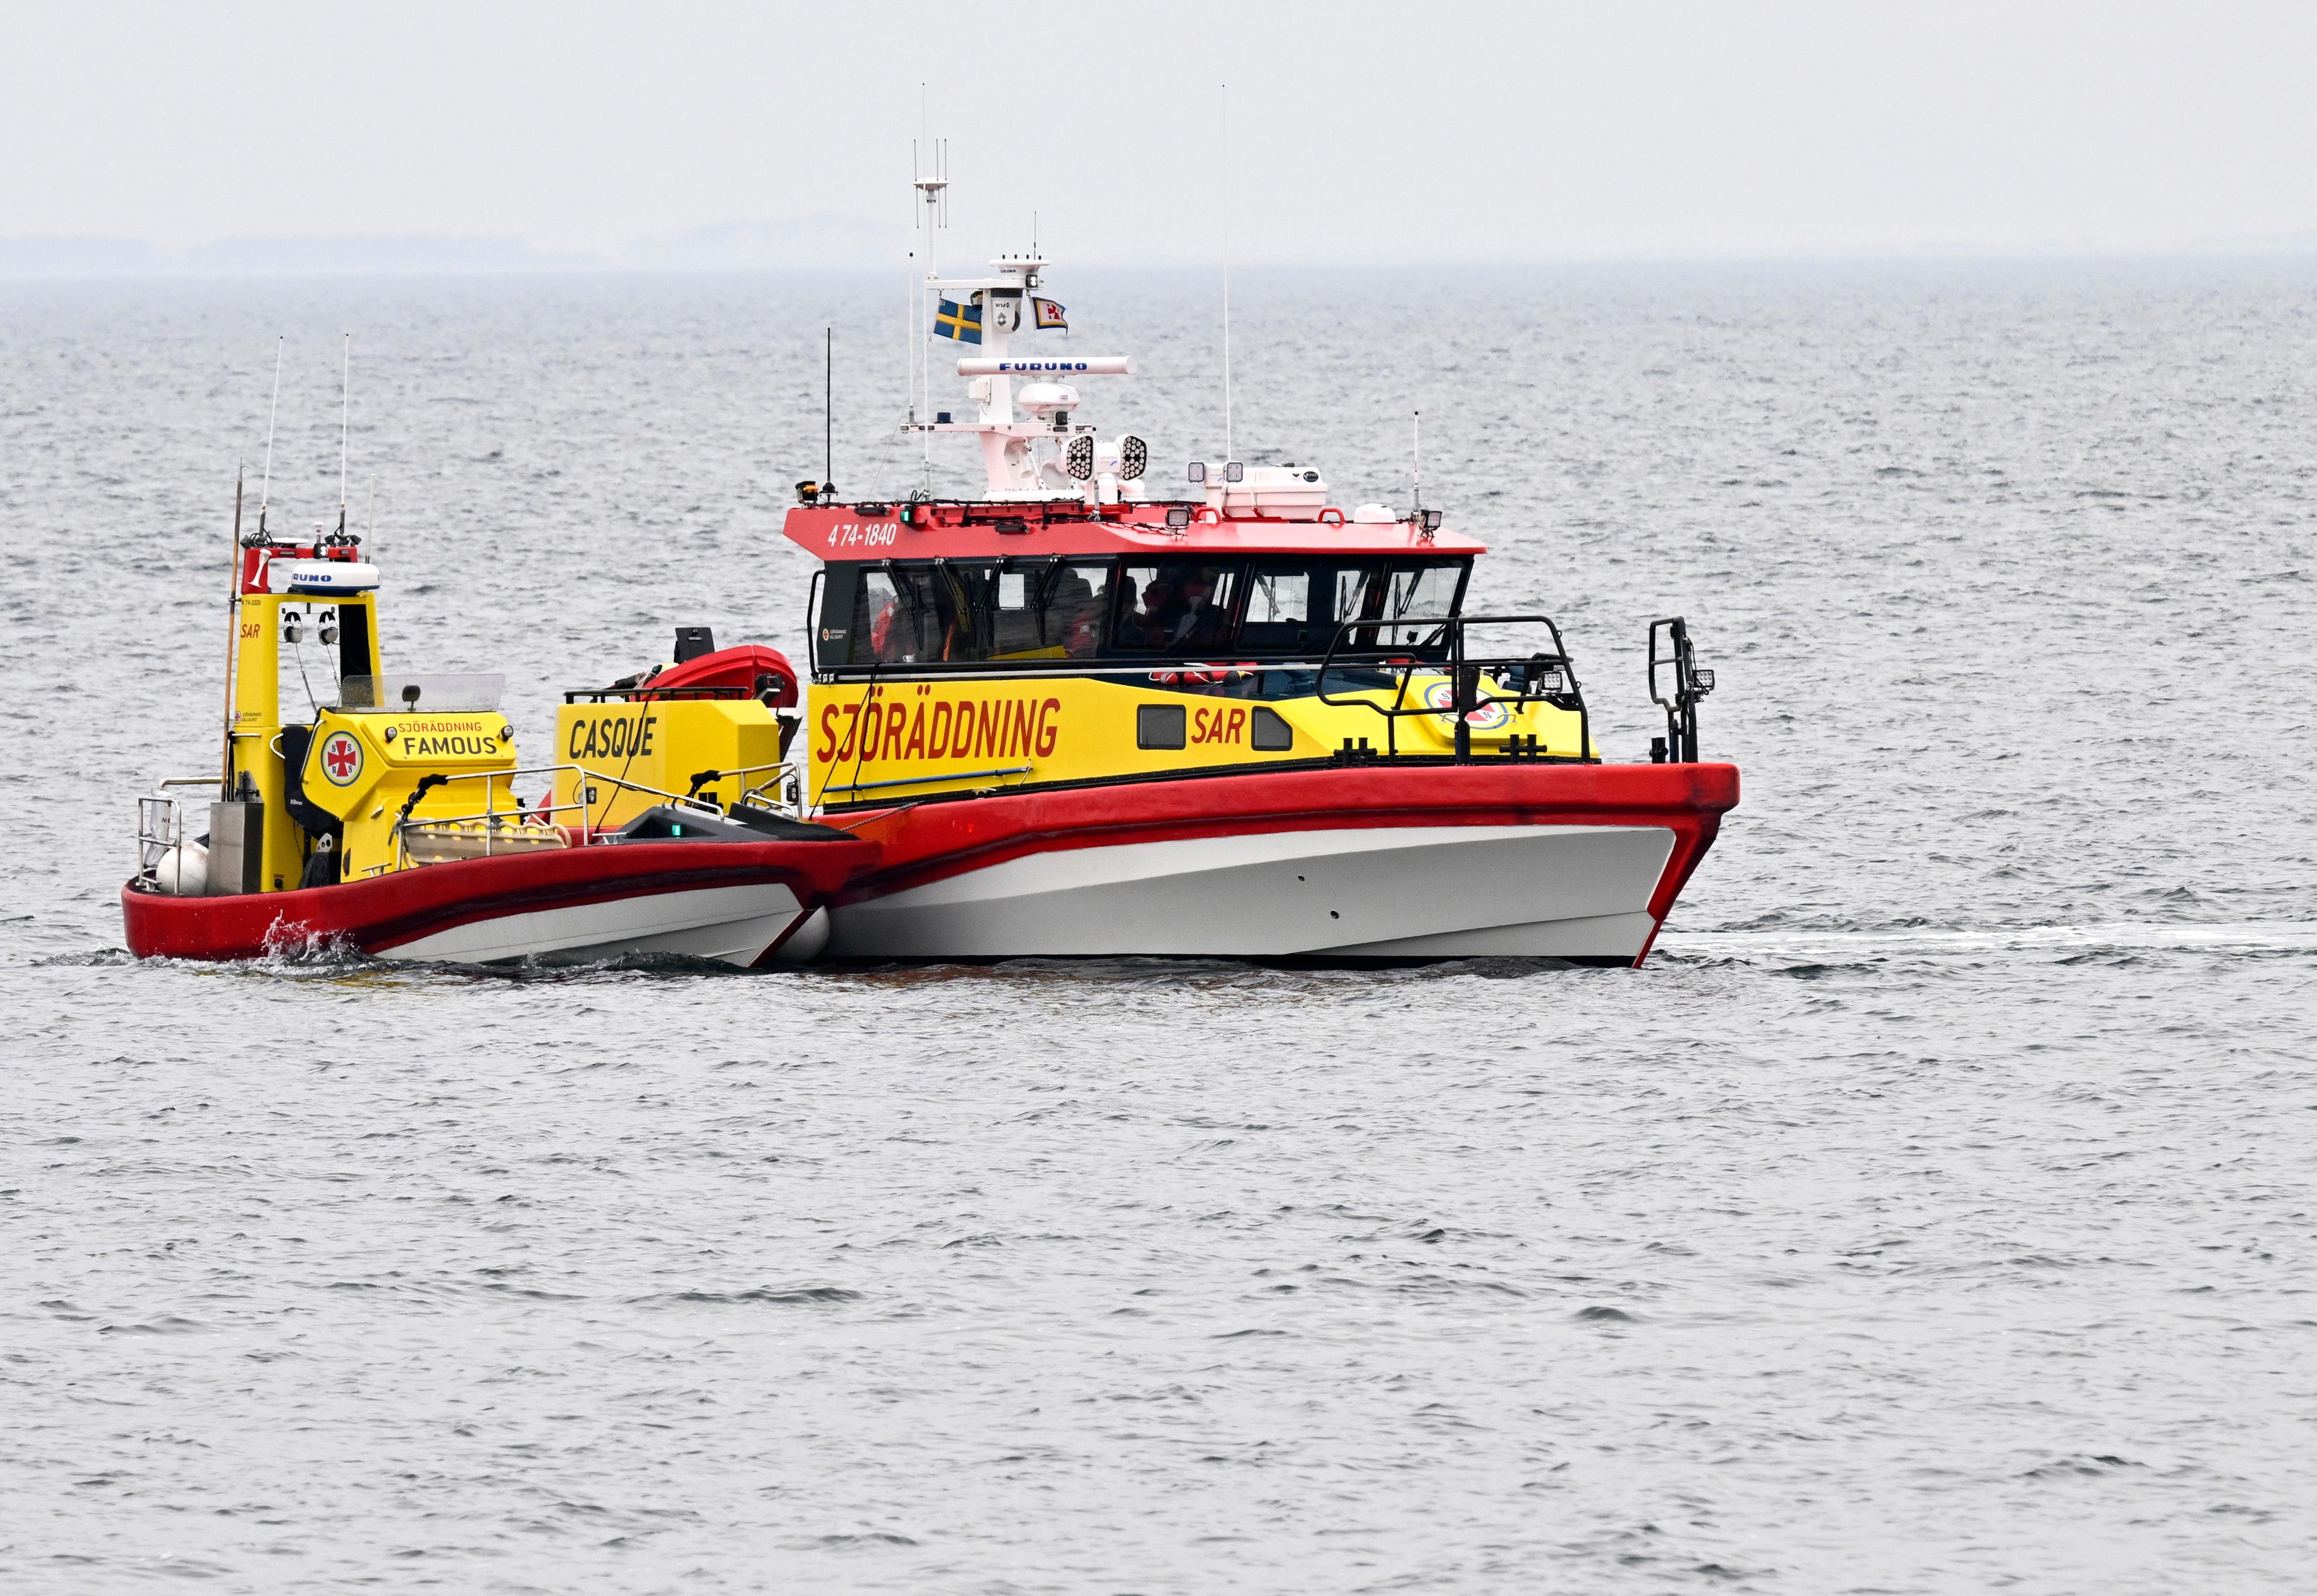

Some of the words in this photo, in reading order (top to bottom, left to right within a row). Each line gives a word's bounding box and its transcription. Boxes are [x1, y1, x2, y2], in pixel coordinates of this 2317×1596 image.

[828, 524, 839, 547] 4
[840, 523, 897, 547] 74-1840
[292, 573, 332, 582] RUNO
[241, 624, 260, 638] SAR
[398, 720, 482, 733] SJÖRÄDDNING
[816, 684, 1061, 763] SJÖRÄDDNING
[1191, 707, 1246, 744] SAR
[404, 737, 497, 755] FAMOUS
[570, 717, 657, 759] CASQUE
[331, 743, 336, 752] S
[347, 743, 352, 752] S
